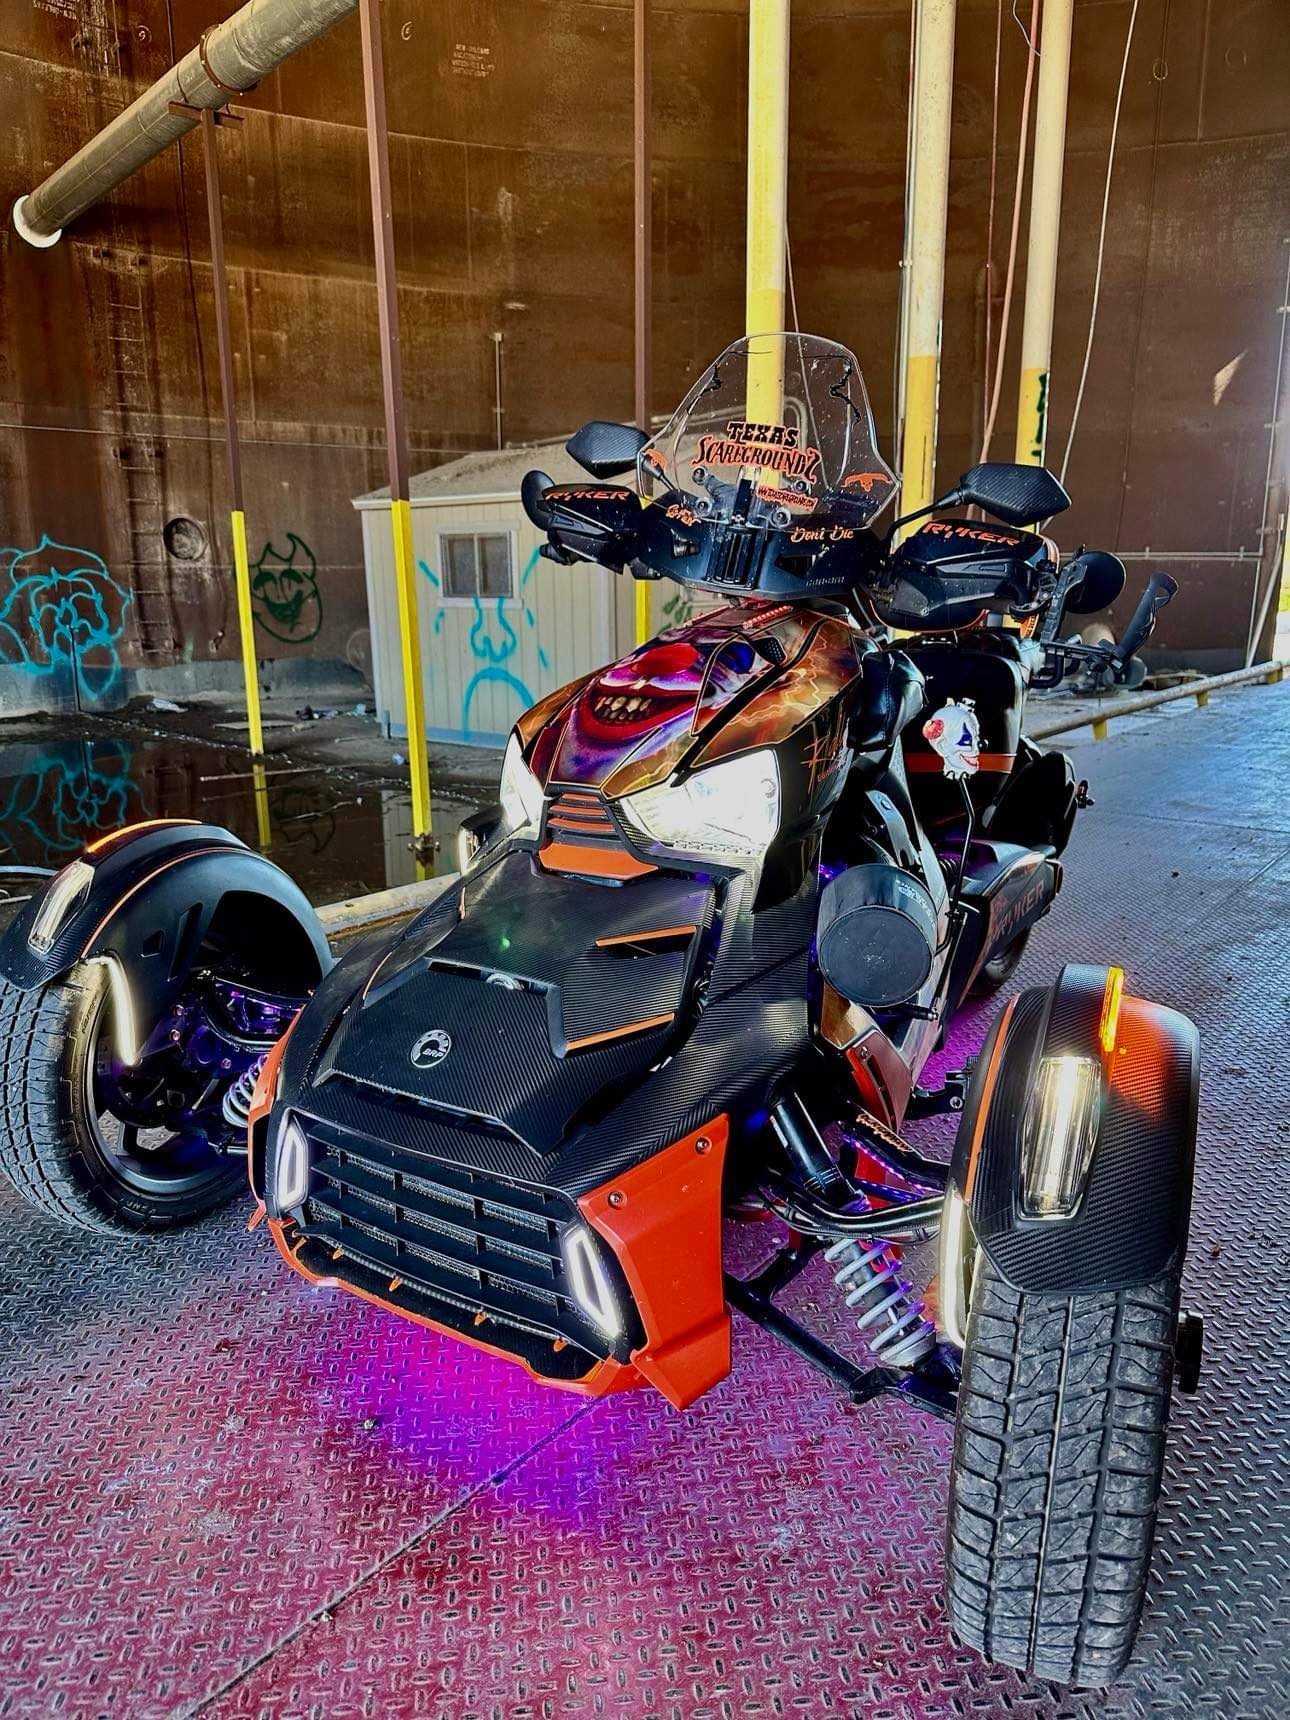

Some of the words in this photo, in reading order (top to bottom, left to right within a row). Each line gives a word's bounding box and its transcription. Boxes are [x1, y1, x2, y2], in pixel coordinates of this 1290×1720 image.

[728, 421, 799, 448] TEXAS
[545, 490, 631, 501] RYKER
[829, 524, 855, 541] Die
[921, 522, 1021, 546] RYKER
[422, 1048, 444, 1058] BRP
